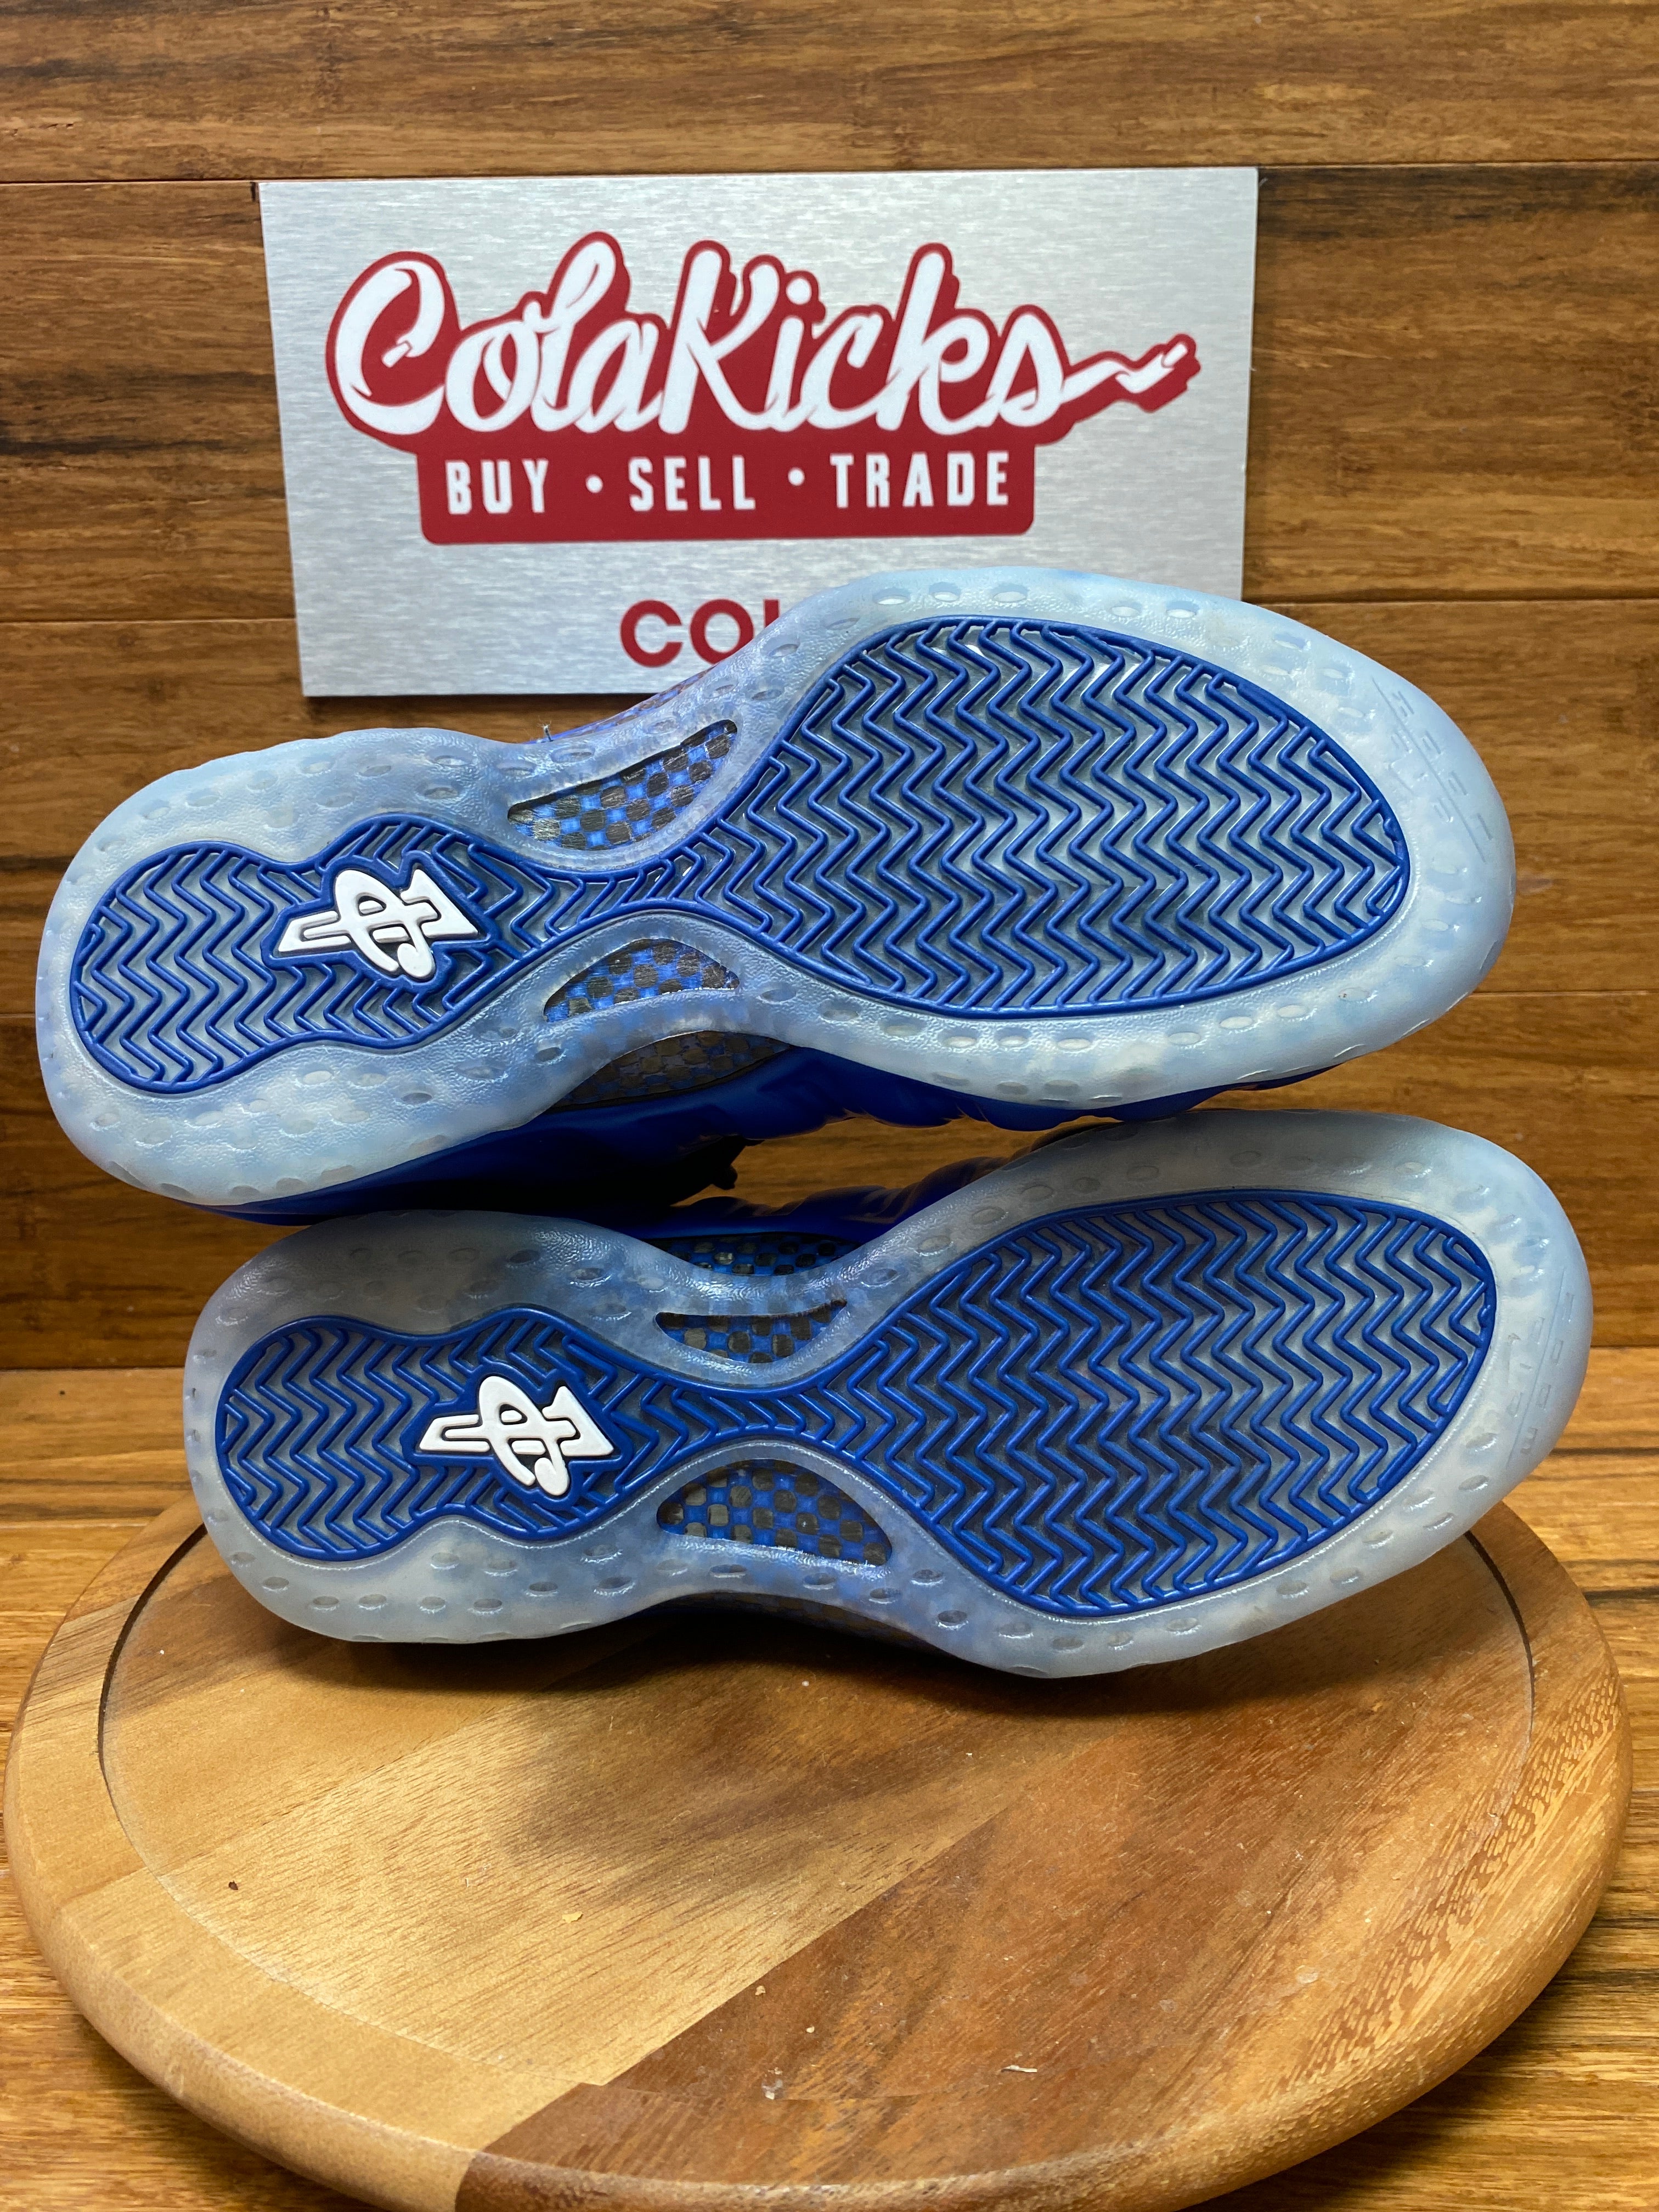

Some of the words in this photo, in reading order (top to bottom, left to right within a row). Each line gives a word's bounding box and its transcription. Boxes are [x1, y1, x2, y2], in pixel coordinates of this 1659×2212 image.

[334, 240, 1188, 434] ColaKicks
[445, 459, 549, 515] BUY
[628, 456, 755, 511] SELL
[830, 450, 1009, 508] TRADE
